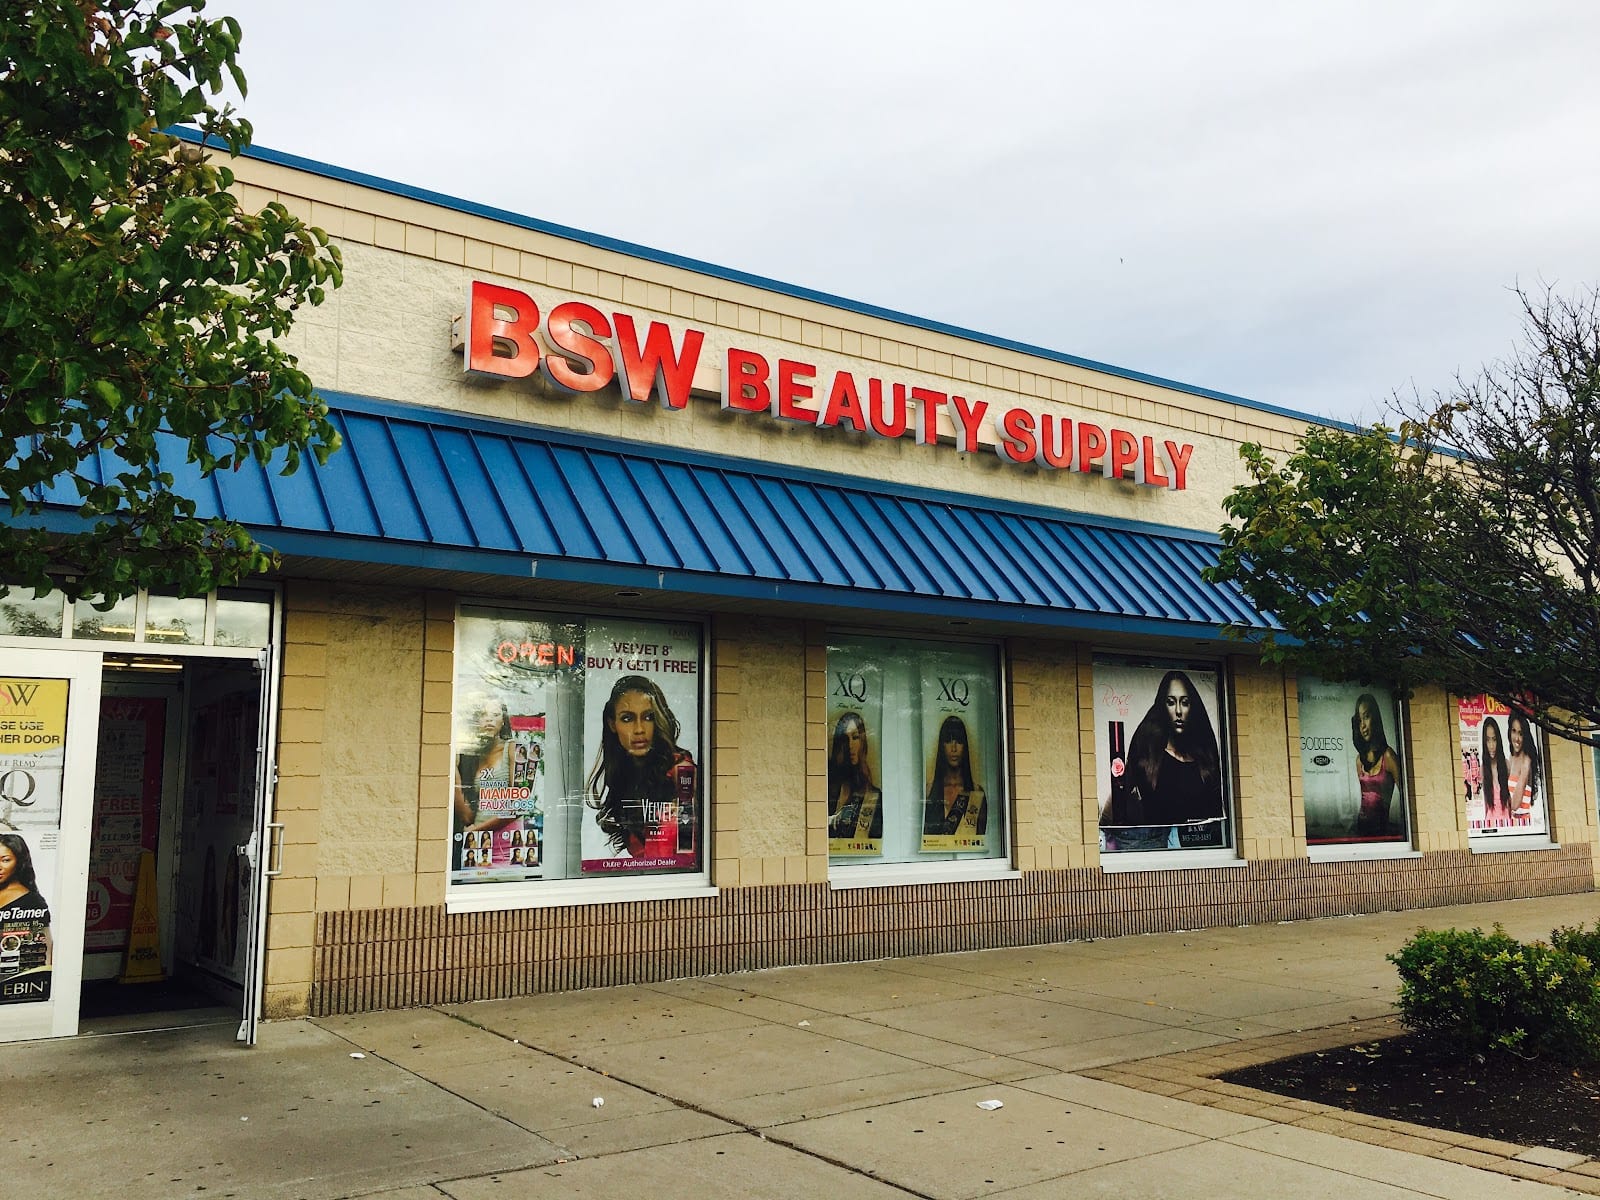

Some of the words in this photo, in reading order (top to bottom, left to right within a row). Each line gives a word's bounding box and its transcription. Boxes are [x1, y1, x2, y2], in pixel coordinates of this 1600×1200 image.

[464, 281, 704, 409] BSW
[721, 348, 988, 453] BEAUTY
[997, 409, 1194, 490] SUPPLY
[497, 642, 575, 666] OPEN
[613, 642, 659, 656] VELVET
[587, 657, 615, 669] BUY
[626, 659, 652, 671] GET
[663, 660, 697, 674] FREE
[833, 671, 867, 703] XQ
[936, 677, 970, 707] XQ
[20, 721, 45, 731] USE
[24, 734, 60, 744] DOOR
[480, 768, 494, 781] 2X
[480, 788, 530, 800] MAMBO
[480, 800, 506, 810] FAUX
[507, 800, 535, 810] LOCS
[641, 798, 674, 823] VELVET
[622, 860, 656, 868] Authorized
[657, 858, 677, 866] Dealer
[4, 981, 44, 996] EBIN
